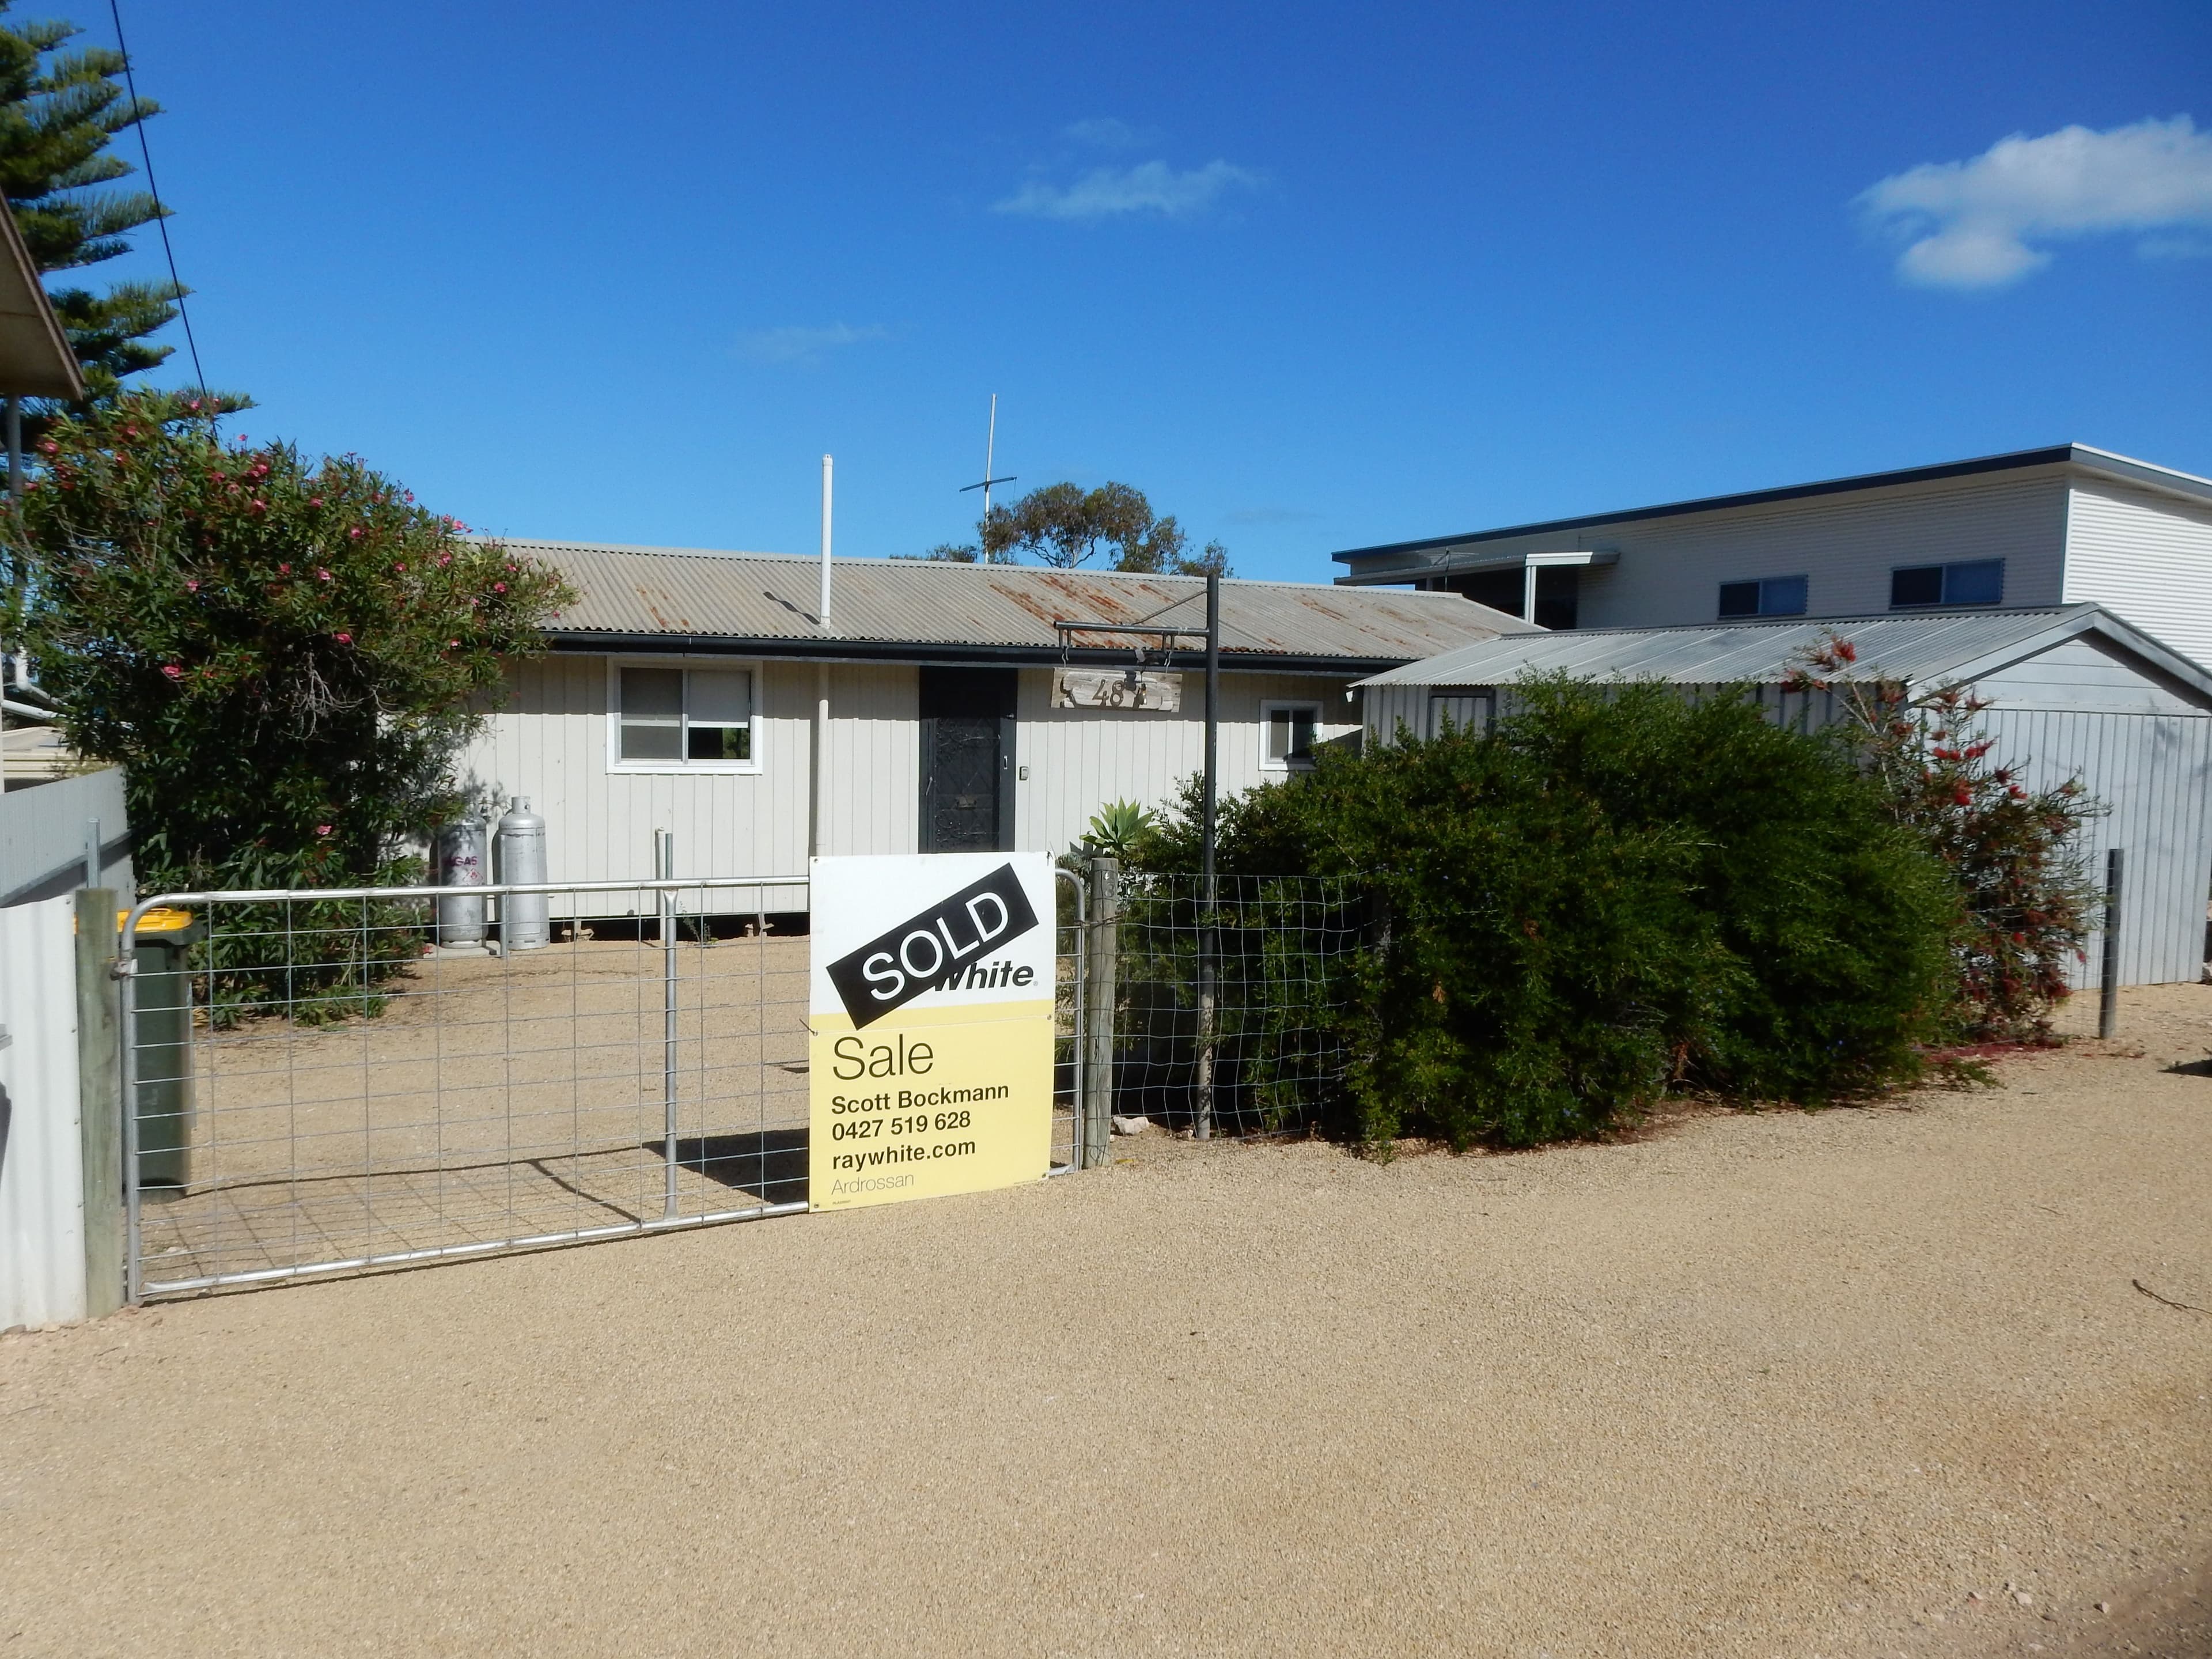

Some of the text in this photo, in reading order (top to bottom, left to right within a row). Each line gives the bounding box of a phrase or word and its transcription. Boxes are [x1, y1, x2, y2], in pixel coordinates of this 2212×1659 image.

[1092, 679, 1125, 707] 48
[862, 892, 1008, 1000] SOLD
[833, 1034, 934, 1080] Sale
[831, 1085, 1009, 1115] Scott Bockmann
[832, 1111, 971, 1141] 0427 519 628
[833, 1141, 975, 1172] raywhite.com
[831, 1174, 914, 1195] Ardrossan
